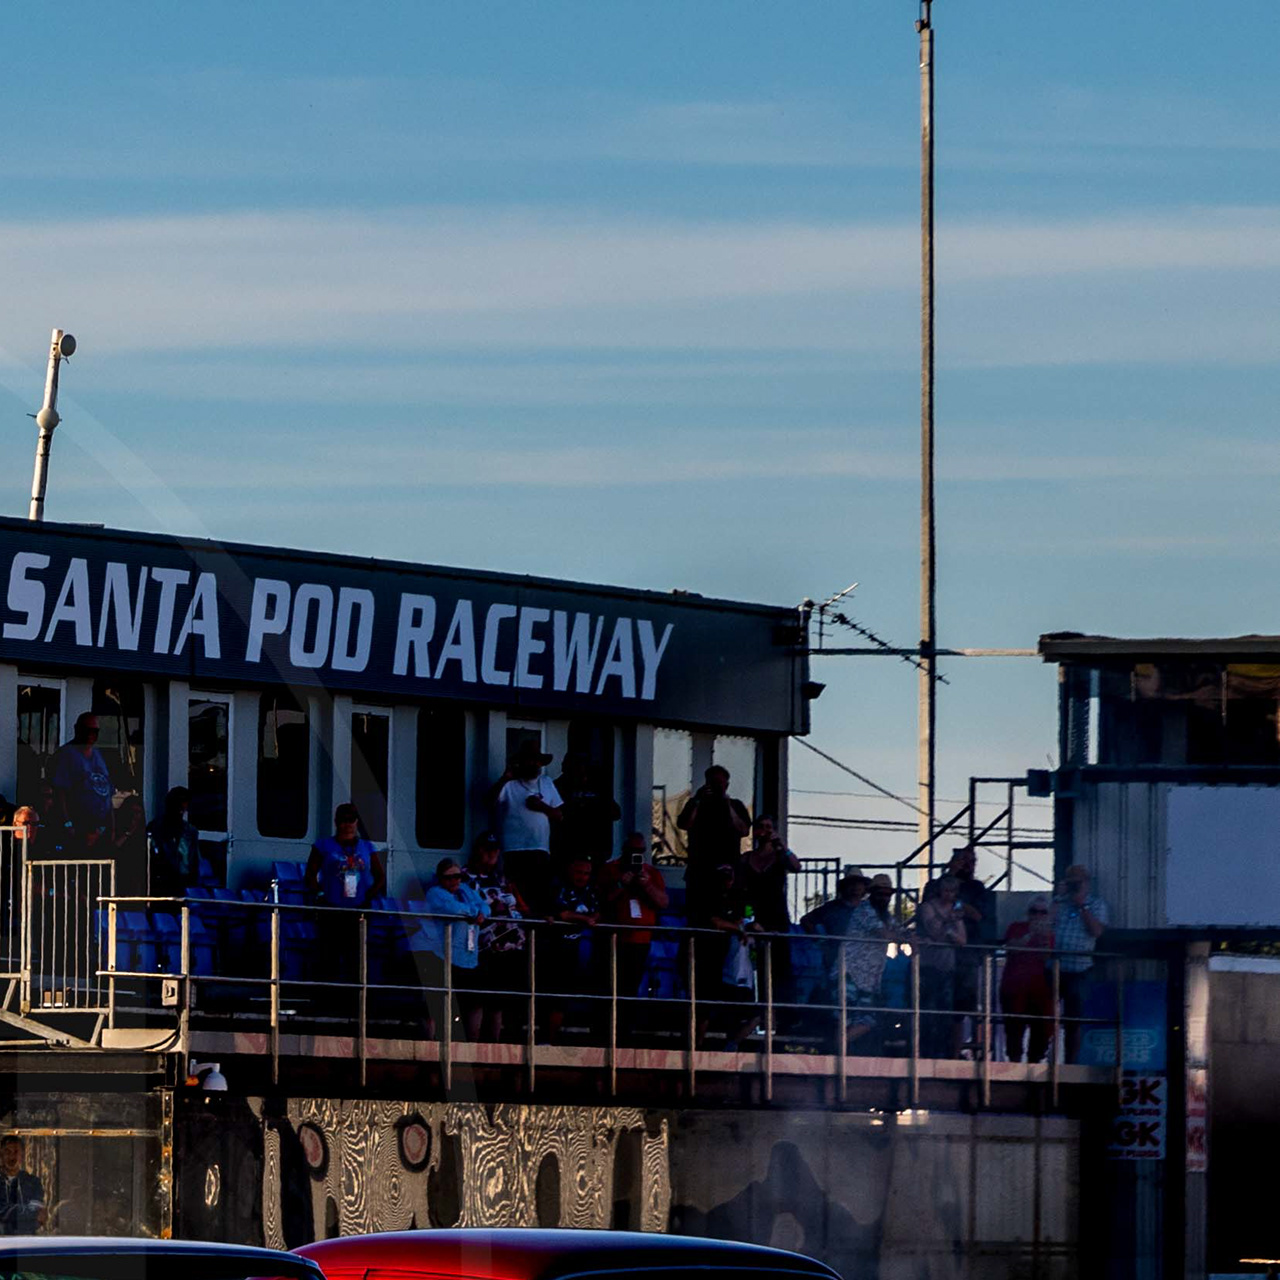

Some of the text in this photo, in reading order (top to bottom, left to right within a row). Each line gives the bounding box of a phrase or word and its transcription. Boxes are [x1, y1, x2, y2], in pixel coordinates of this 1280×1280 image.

[1, 551, 674, 702] SANTA POD RACEWAY
